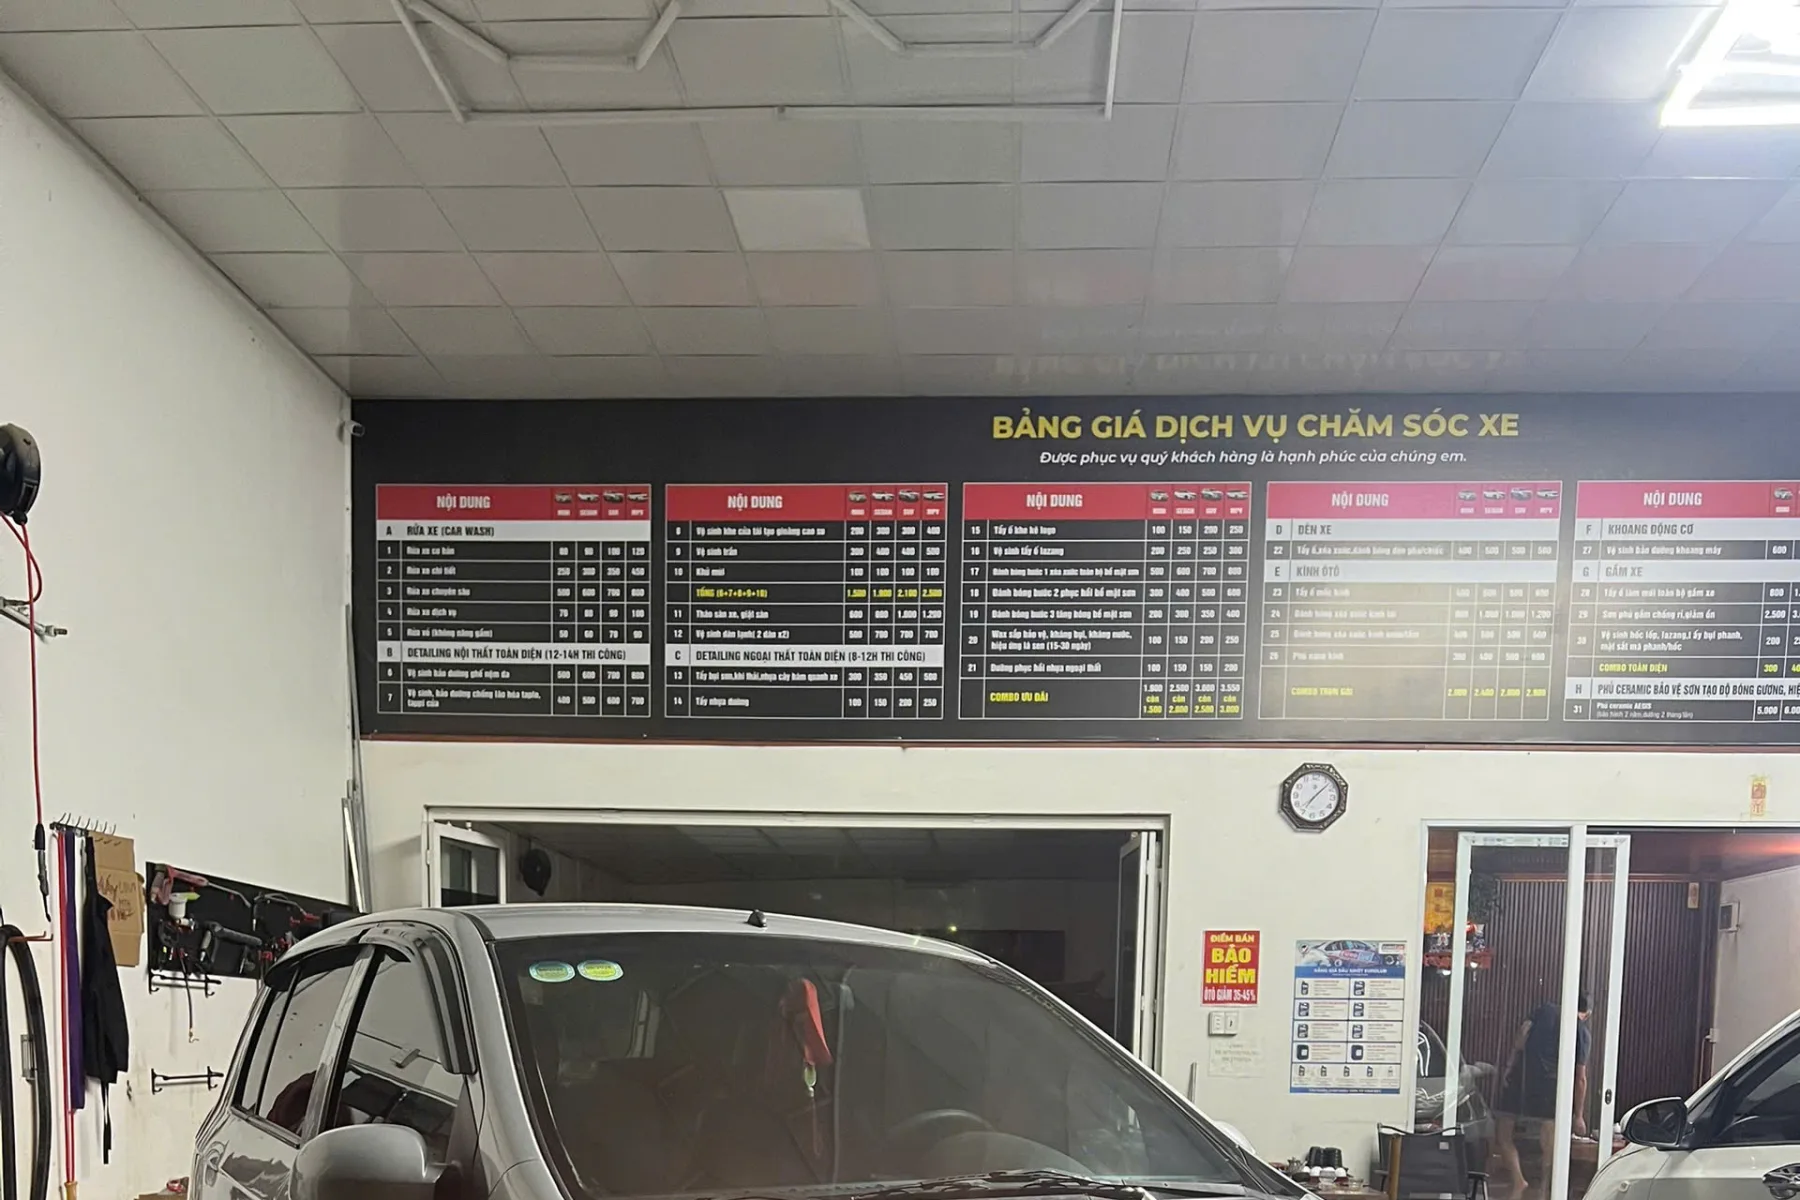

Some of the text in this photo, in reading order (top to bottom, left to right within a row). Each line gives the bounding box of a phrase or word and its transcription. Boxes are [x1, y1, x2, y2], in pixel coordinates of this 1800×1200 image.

[993, 408, 1518, 444] BẢNG GIÁ DỊCH VỤ CHĂM SÓC XE
[1040, 450, 1467, 465] Được phục vụ quý khách hàng là hạnh phúc của chúng em.
[437, 494, 490, 510] NỘI DUNG
[728, 494, 782, 511] NỘI DUNG
[1027, 492, 1082, 509] NỘI DUNG
[1332, 491, 1388, 509] NỘI DUNG
[1644, 490, 1702, 508] NỘI DUNG
[386, 526, 392, 535] A
[442, 526, 462, 536] (CAR
[465, 526, 494, 536] WASH)
[1276, 525, 1282, 534] D
[1586, 525, 1592, 534] F
[1608, 524, 1648, 534] KHOANG
[1275, 566, 1280, 576] E
[1583, 566, 1589, 576] G
[387, 646, 626, 660] B DETAILING NỘI THẤT TOÀN DIỆN (12-14H THI CÔNG)
[675, 650, 925, 663] C DETAILING NGOẠI THẤT TOÀN DIỆN (8-12H THI CÔNG)
[1628, 662, 1648, 672] TOÀN
[1650, 662, 1667, 673] DIỆN
[1576, 684, 1582, 694] H
[1616, 684, 1651, 694] CERAMIC
[1212, 944, 1251, 963] BẢO
[1206, 964, 1256, 983] HIỂM
